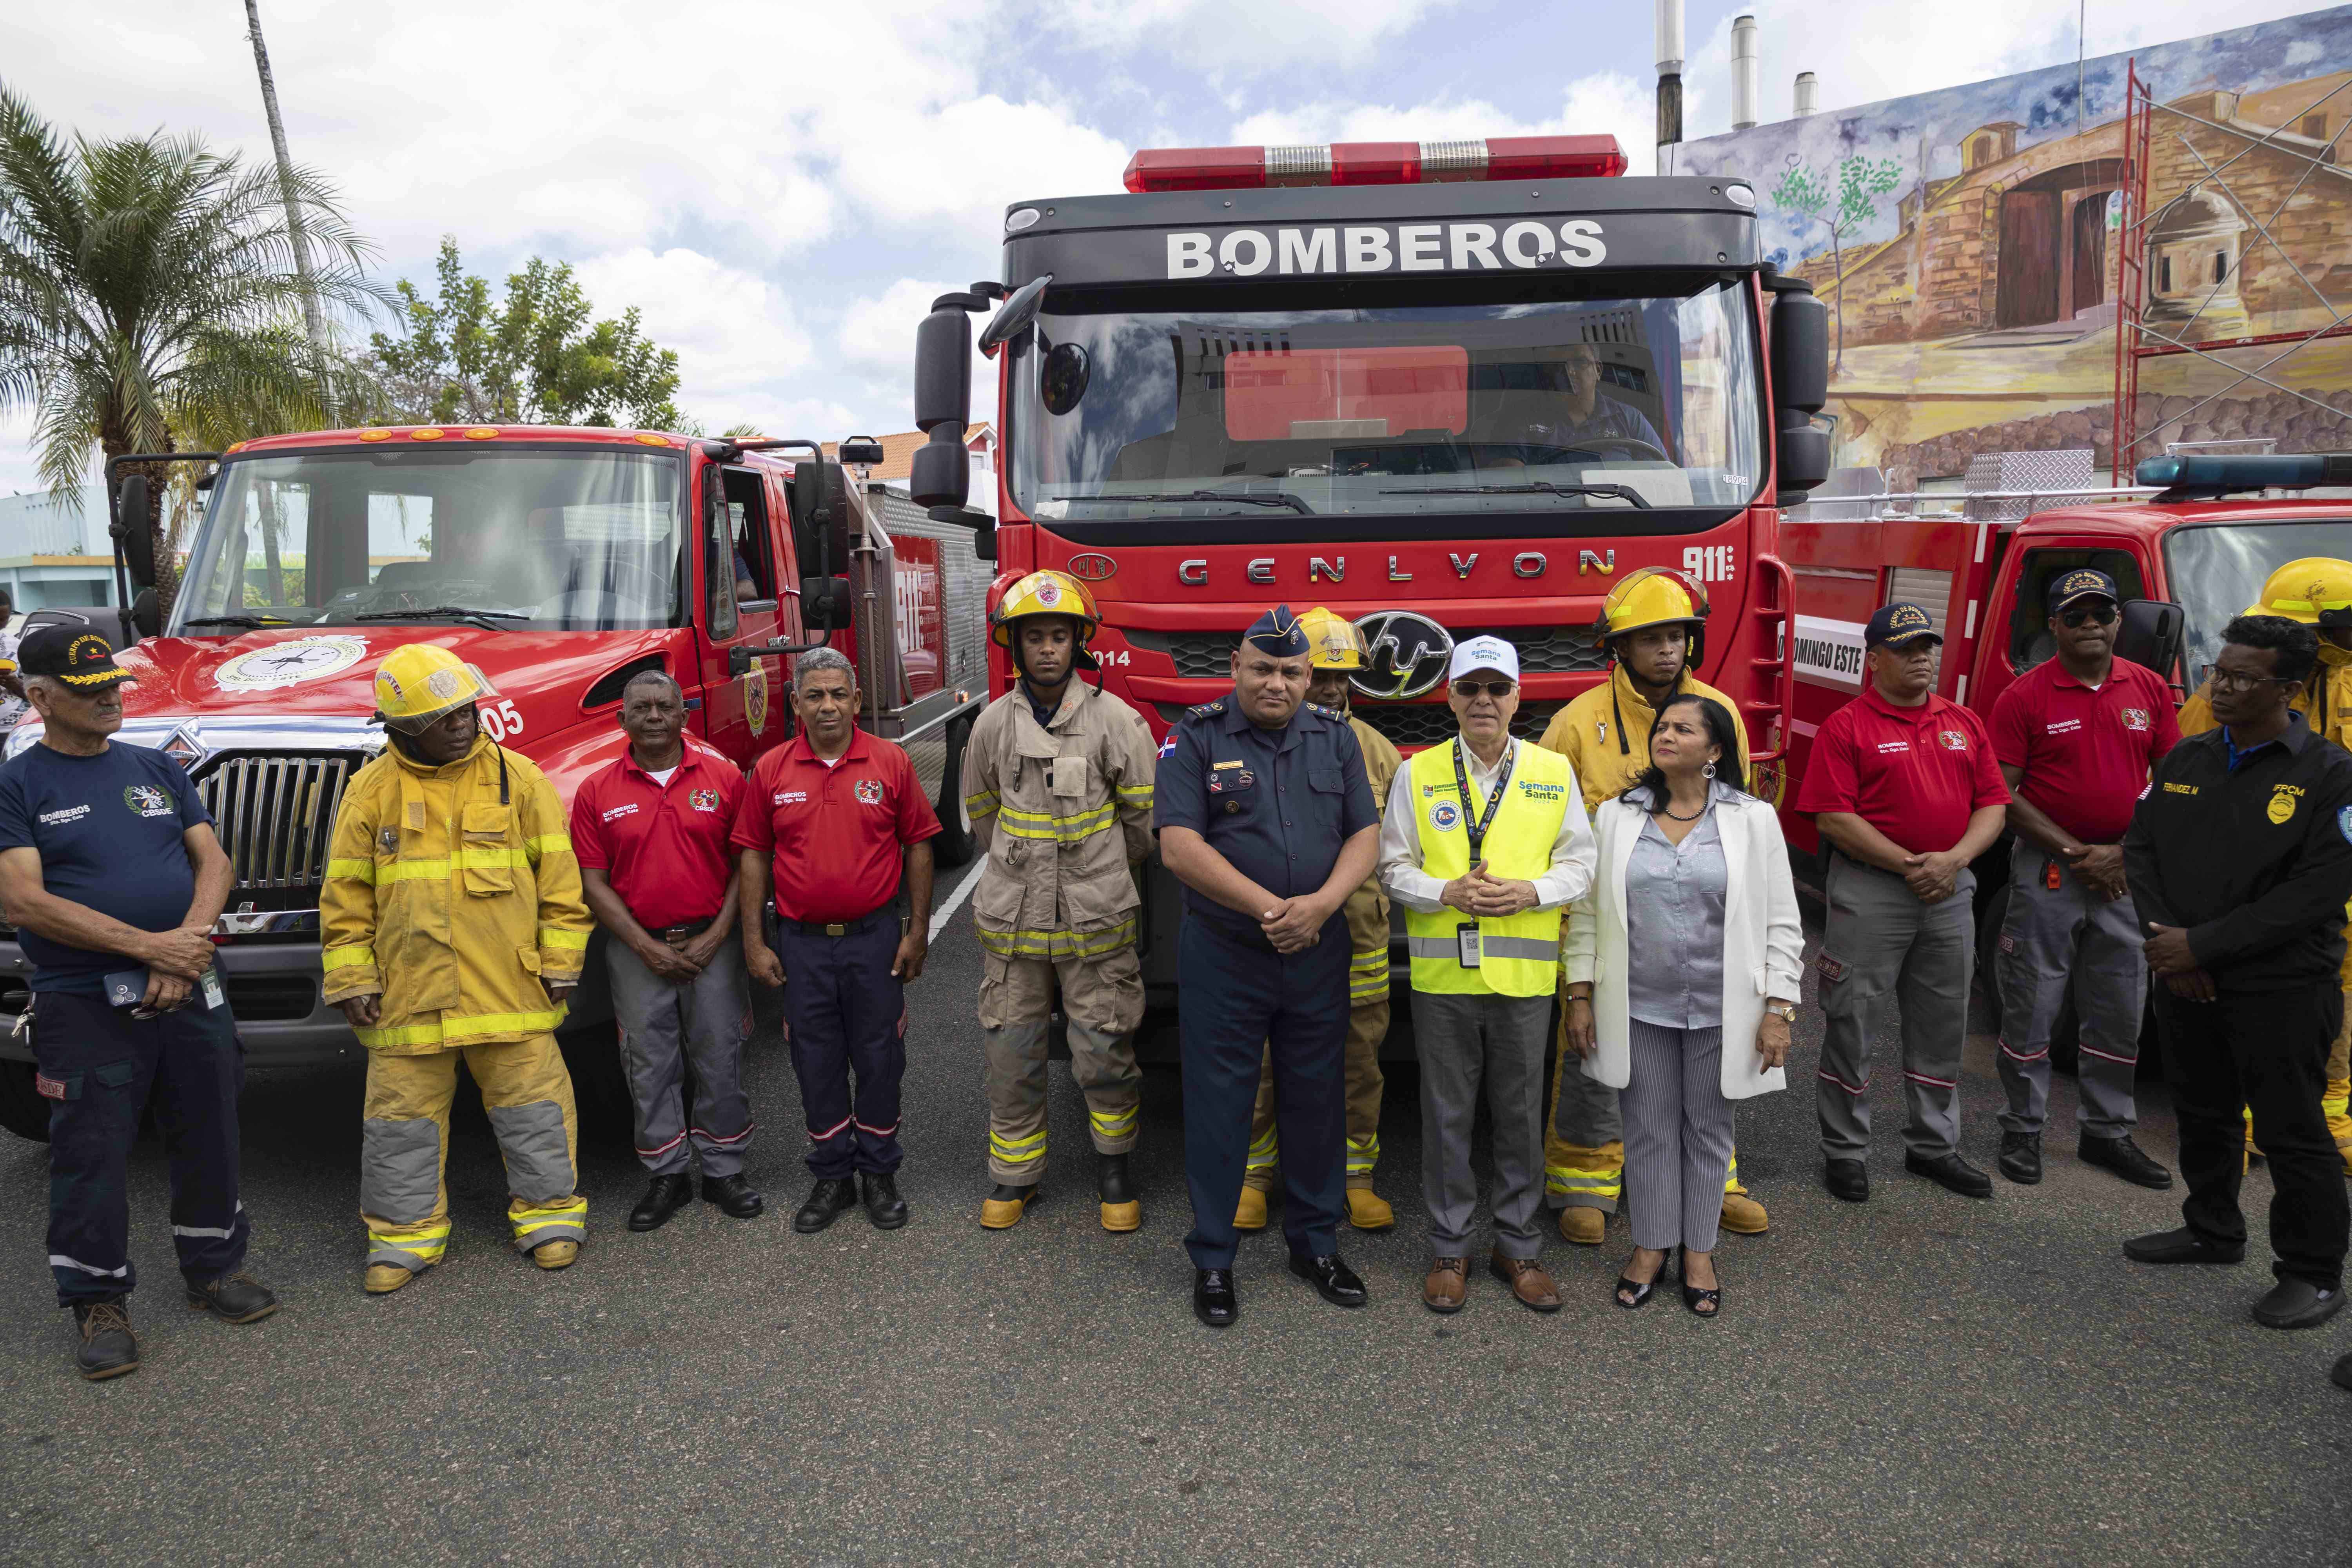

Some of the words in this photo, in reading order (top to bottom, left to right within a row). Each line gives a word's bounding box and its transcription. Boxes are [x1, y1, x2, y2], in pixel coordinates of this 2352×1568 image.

[1167, 220, 1606, 279] BOMBEROS
[1724, 475, 1747, 485] 18904
[1179, 550, 1614, 584] GENLYON
[1684, 546, 1725, 582] 911
[2063, 577, 2075, 594] CUERPO
[895, 570, 920, 655] 911
[1889, 610, 1901, 629] CUERPO
[69, 640, 81, 664] CUERPO
[321, 642, 356, 661] BOMBEROS
[1471, 649, 1501, 657] Semana
[1833, 644, 1862, 675] ESTE
[480, 699, 524, 742] 05
[2047, 719, 2080, 730] BOMBEROS
[1519, 780, 1564, 793] Semana
[1525, 789, 1558, 800] Santa
[775, 791, 807, 800] BOMBEROS
[40, 804, 91, 822] BOMBEROS
[142, 808, 174, 817] CBSDE
[603, 803, 638, 818] BOMBEROS
[1431, 802, 1448, 815] DEFENSA
[1450, 803, 1459, 811] CIVIL
